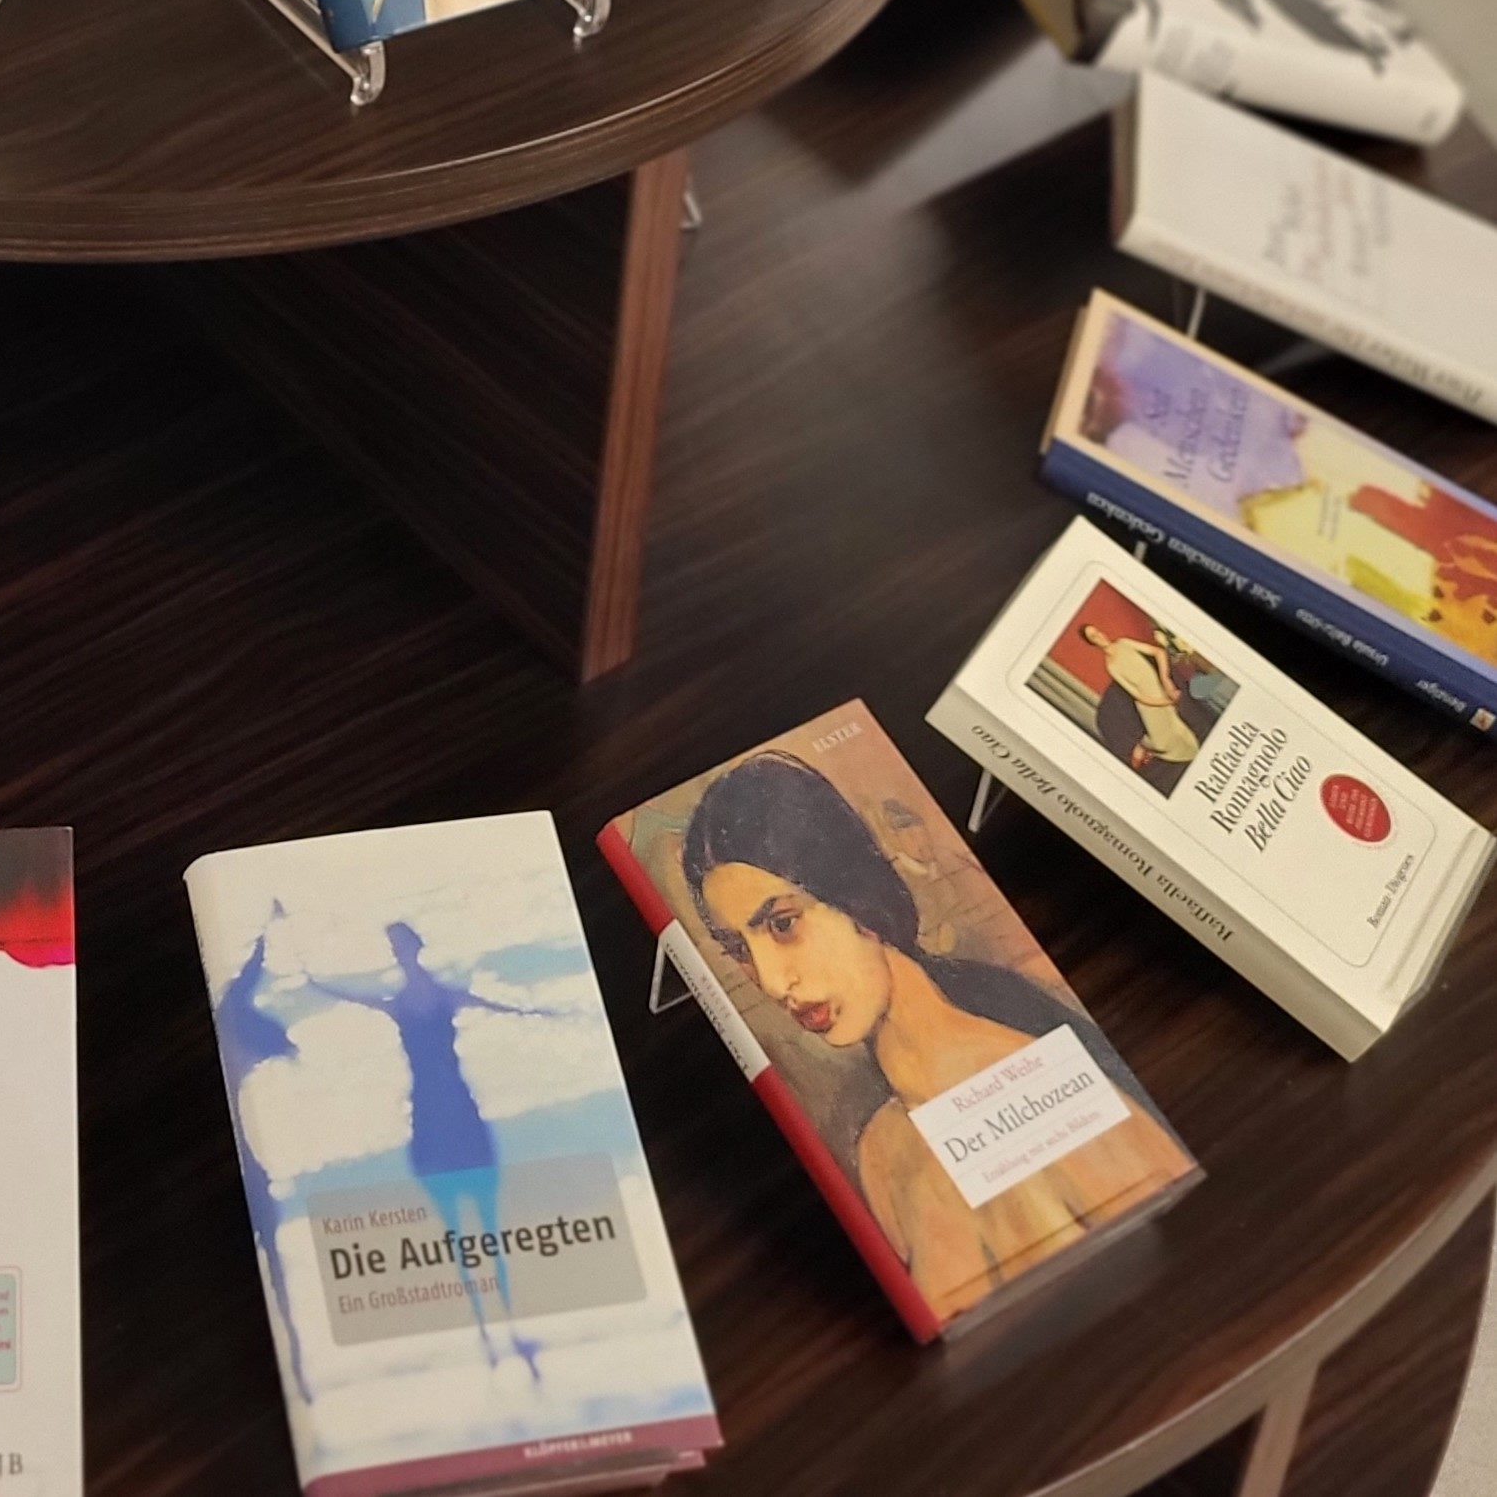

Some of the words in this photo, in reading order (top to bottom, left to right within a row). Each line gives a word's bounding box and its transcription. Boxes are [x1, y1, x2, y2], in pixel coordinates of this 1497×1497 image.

[1086, 491, 1166, 546] Gedenken
[1166, 536, 1252, 596] Menschen
[970, 724, 1011, 760] Ciao
[1193, 720, 1261, 804] Raffaella
[1010, 757, 1057, 796] Bella
[1208, 727, 1288, 835] Romagnolo
[1243, 798, 1288, 854] Bella
[1272, 754, 1313, 803] Ciao
[1056, 791, 1154, 877] Romagnolo
[1156, 873, 1235, 942] Raffaella
[952, 1075, 1004, 1114] Richard
[1000, 1055, 1046, 1083] Weihe
[944, 1130, 988, 1163] Der
[983, 1070, 1096, 1142] Milchozean
[322, 1210, 365, 1235] Karin
[368, 1205, 428, 1228] Kersten
[329, 1242, 387, 1280] Die
[400, 1213, 617, 1269] Aufgeregten
[338, 1292, 365, 1315] Ein
[368, 1274, 501, 1310] Großstadtroman
